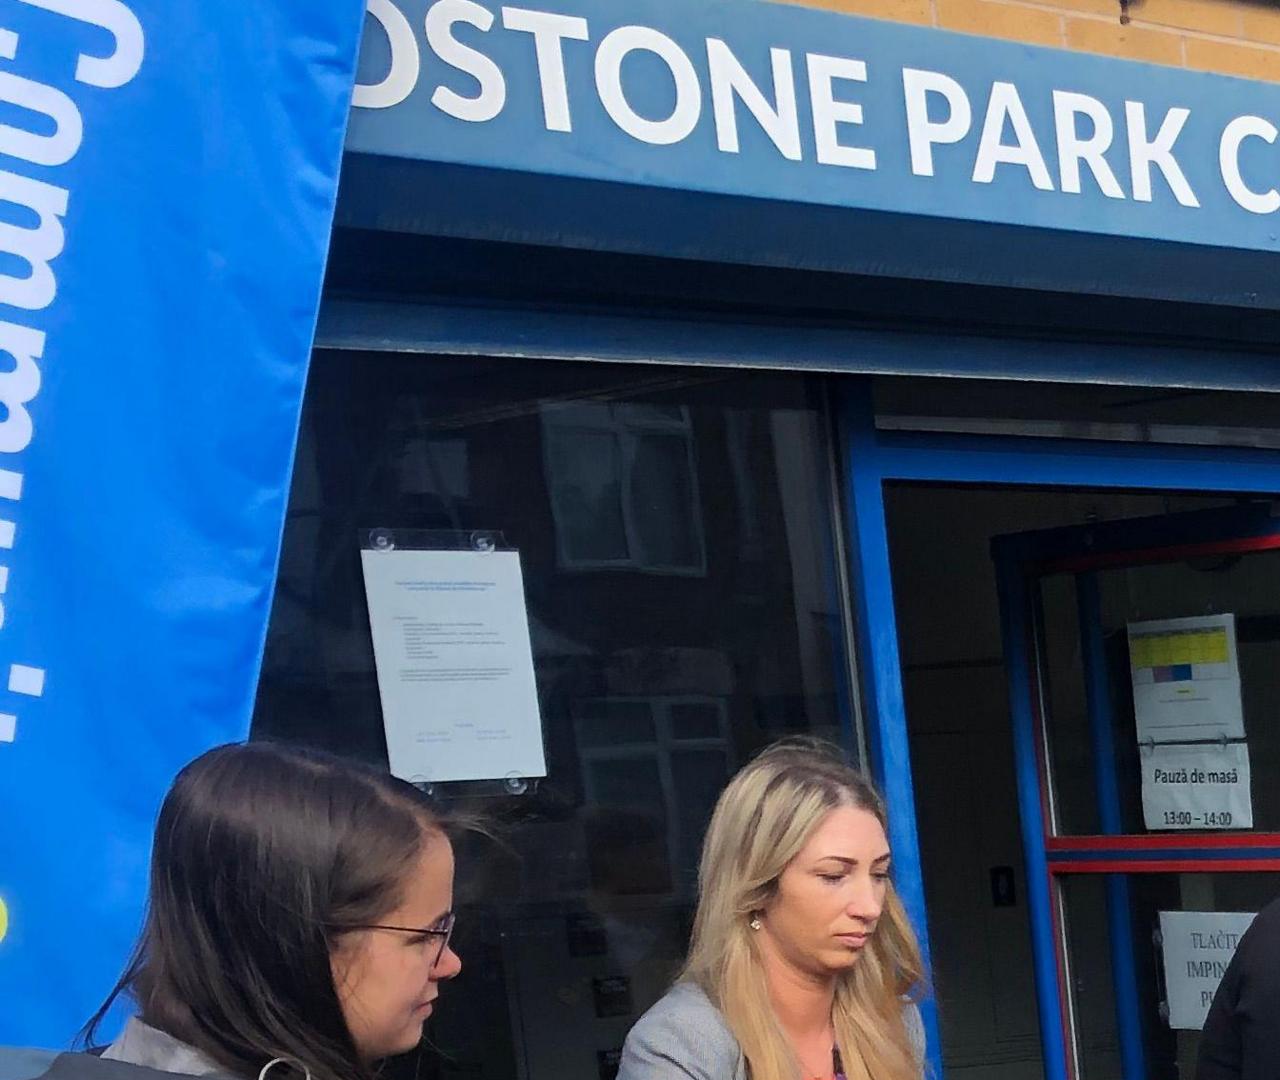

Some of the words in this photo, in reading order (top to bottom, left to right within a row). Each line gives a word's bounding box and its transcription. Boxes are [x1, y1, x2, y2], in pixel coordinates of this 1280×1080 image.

[902, 66, 1201, 208] PARK
[1190, 768, 1205, 783] de
[1164, 811, 1191, 825] 13:00
[1203, 812, 1232, 826] 14:00
